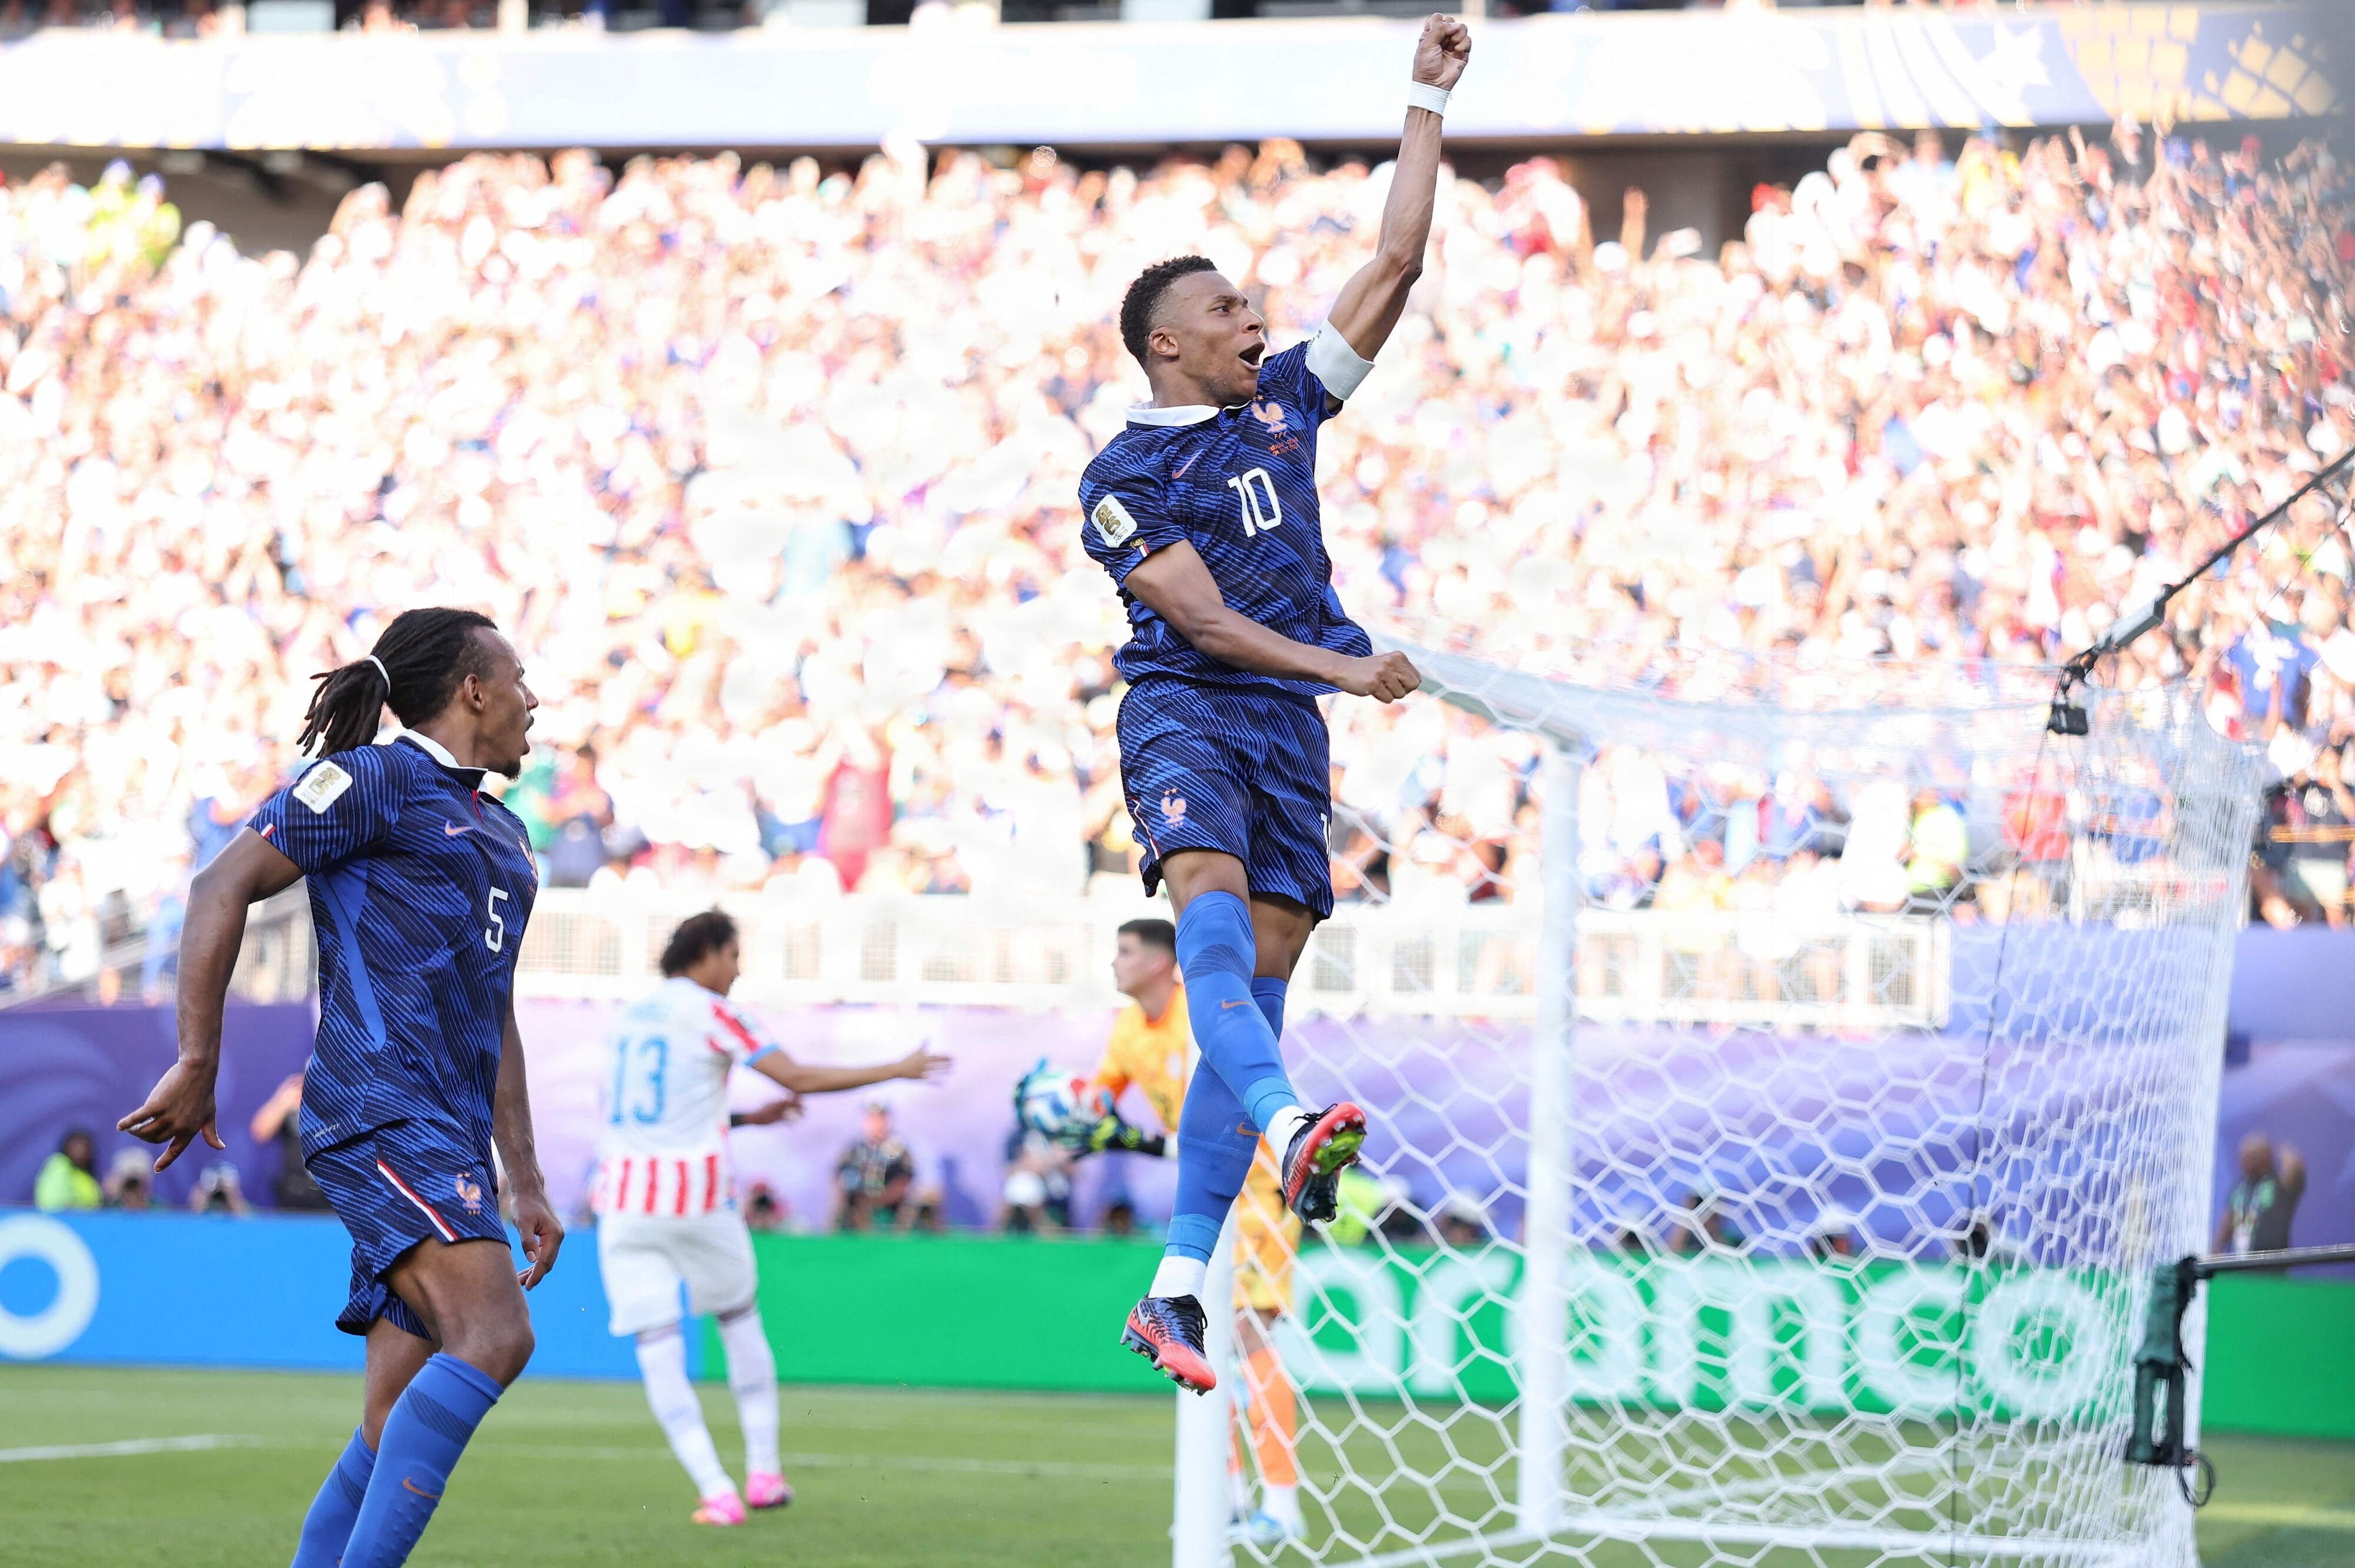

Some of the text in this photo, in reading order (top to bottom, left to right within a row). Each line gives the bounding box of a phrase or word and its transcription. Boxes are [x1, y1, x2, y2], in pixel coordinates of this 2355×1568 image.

[1228, 467, 1282, 538] 10
[1321, 812, 1332, 863] 1
[485, 886, 509, 954] 5
[609, 1035, 669, 1125] 13
[1271, 1247, 2115, 1413] aramco
